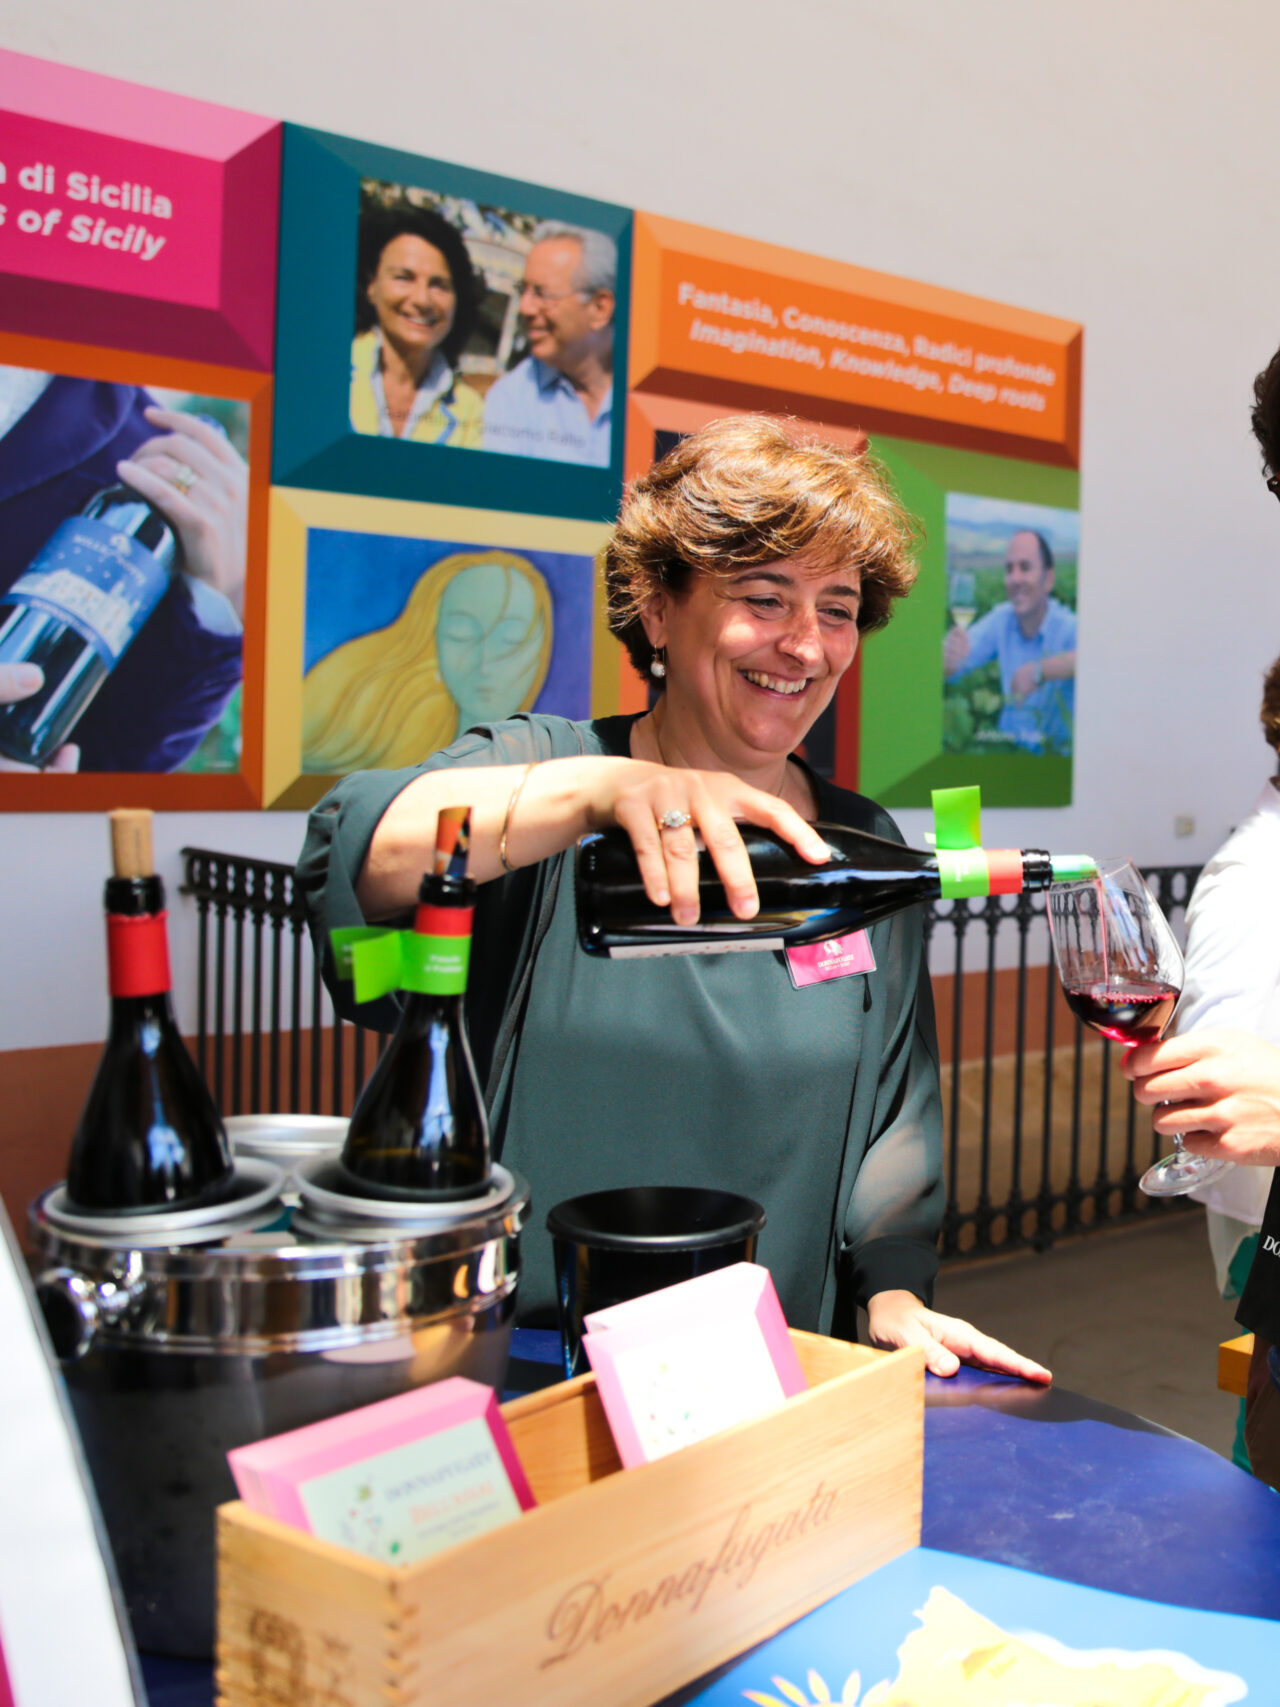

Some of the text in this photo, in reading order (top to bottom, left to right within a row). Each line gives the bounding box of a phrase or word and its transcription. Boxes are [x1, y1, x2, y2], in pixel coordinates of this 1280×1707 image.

[17, 208, 63, 236] of
[66, 214, 167, 261] Sicily
[18, 162, 55, 195] di
[66, 171, 173, 220] Sicilia
[677, 281, 1056, 387] Fantasia, Conoscenza, Radici profonde
[689, 318, 1047, 412] Imagination, Knowledge, Deep roots
[537, 1480, 841, 1670] Donnafugata
